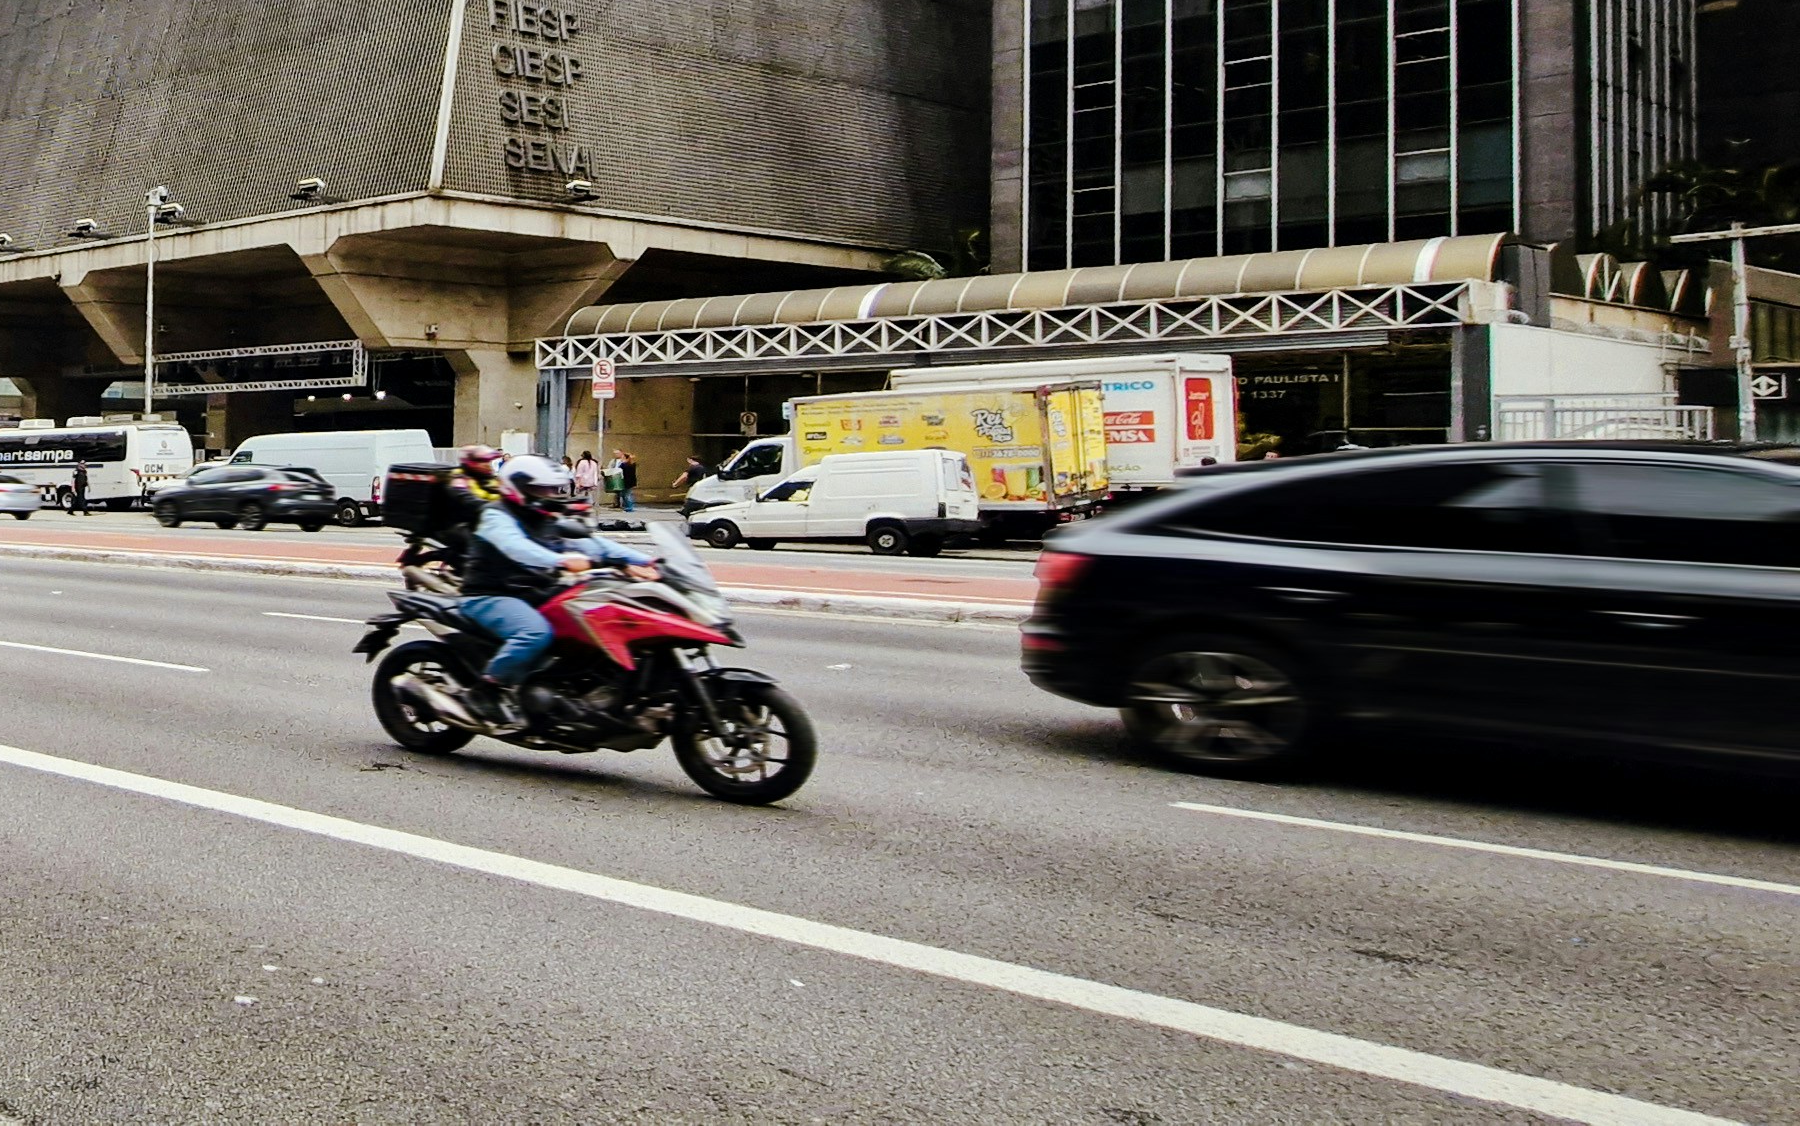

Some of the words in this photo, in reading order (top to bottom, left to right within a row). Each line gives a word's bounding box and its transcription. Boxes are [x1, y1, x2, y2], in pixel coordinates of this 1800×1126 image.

[501, 90, 569, 130] SESI
[505, 137, 598, 178] SENAI
[1254, 374, 1329, 385] PAULISTA
[1103, 381, 1154, 391] TRICO
[1104, 430, 1150, 442] EMSA
